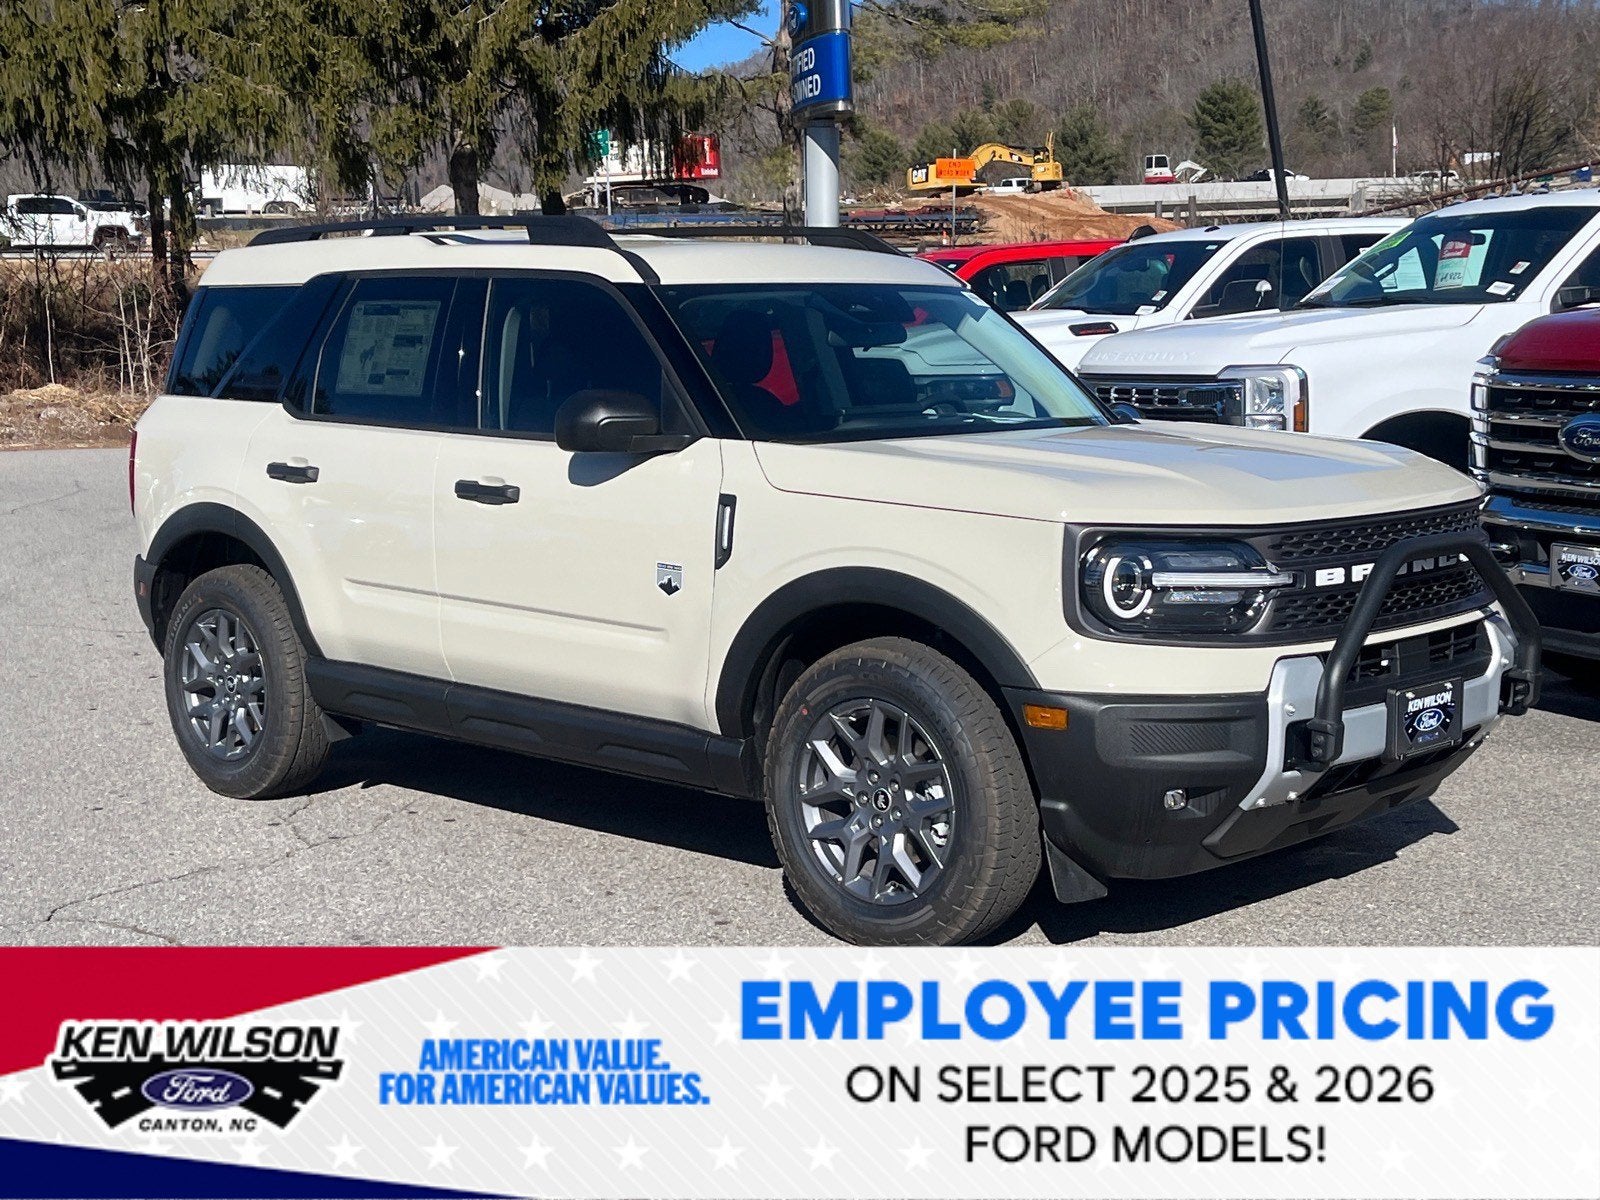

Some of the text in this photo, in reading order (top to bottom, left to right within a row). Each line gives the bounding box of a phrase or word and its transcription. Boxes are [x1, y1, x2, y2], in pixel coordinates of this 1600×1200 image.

[912, 168, 927, 183] CAT
[1407, 690, 1453, 713] KEN WILSON
